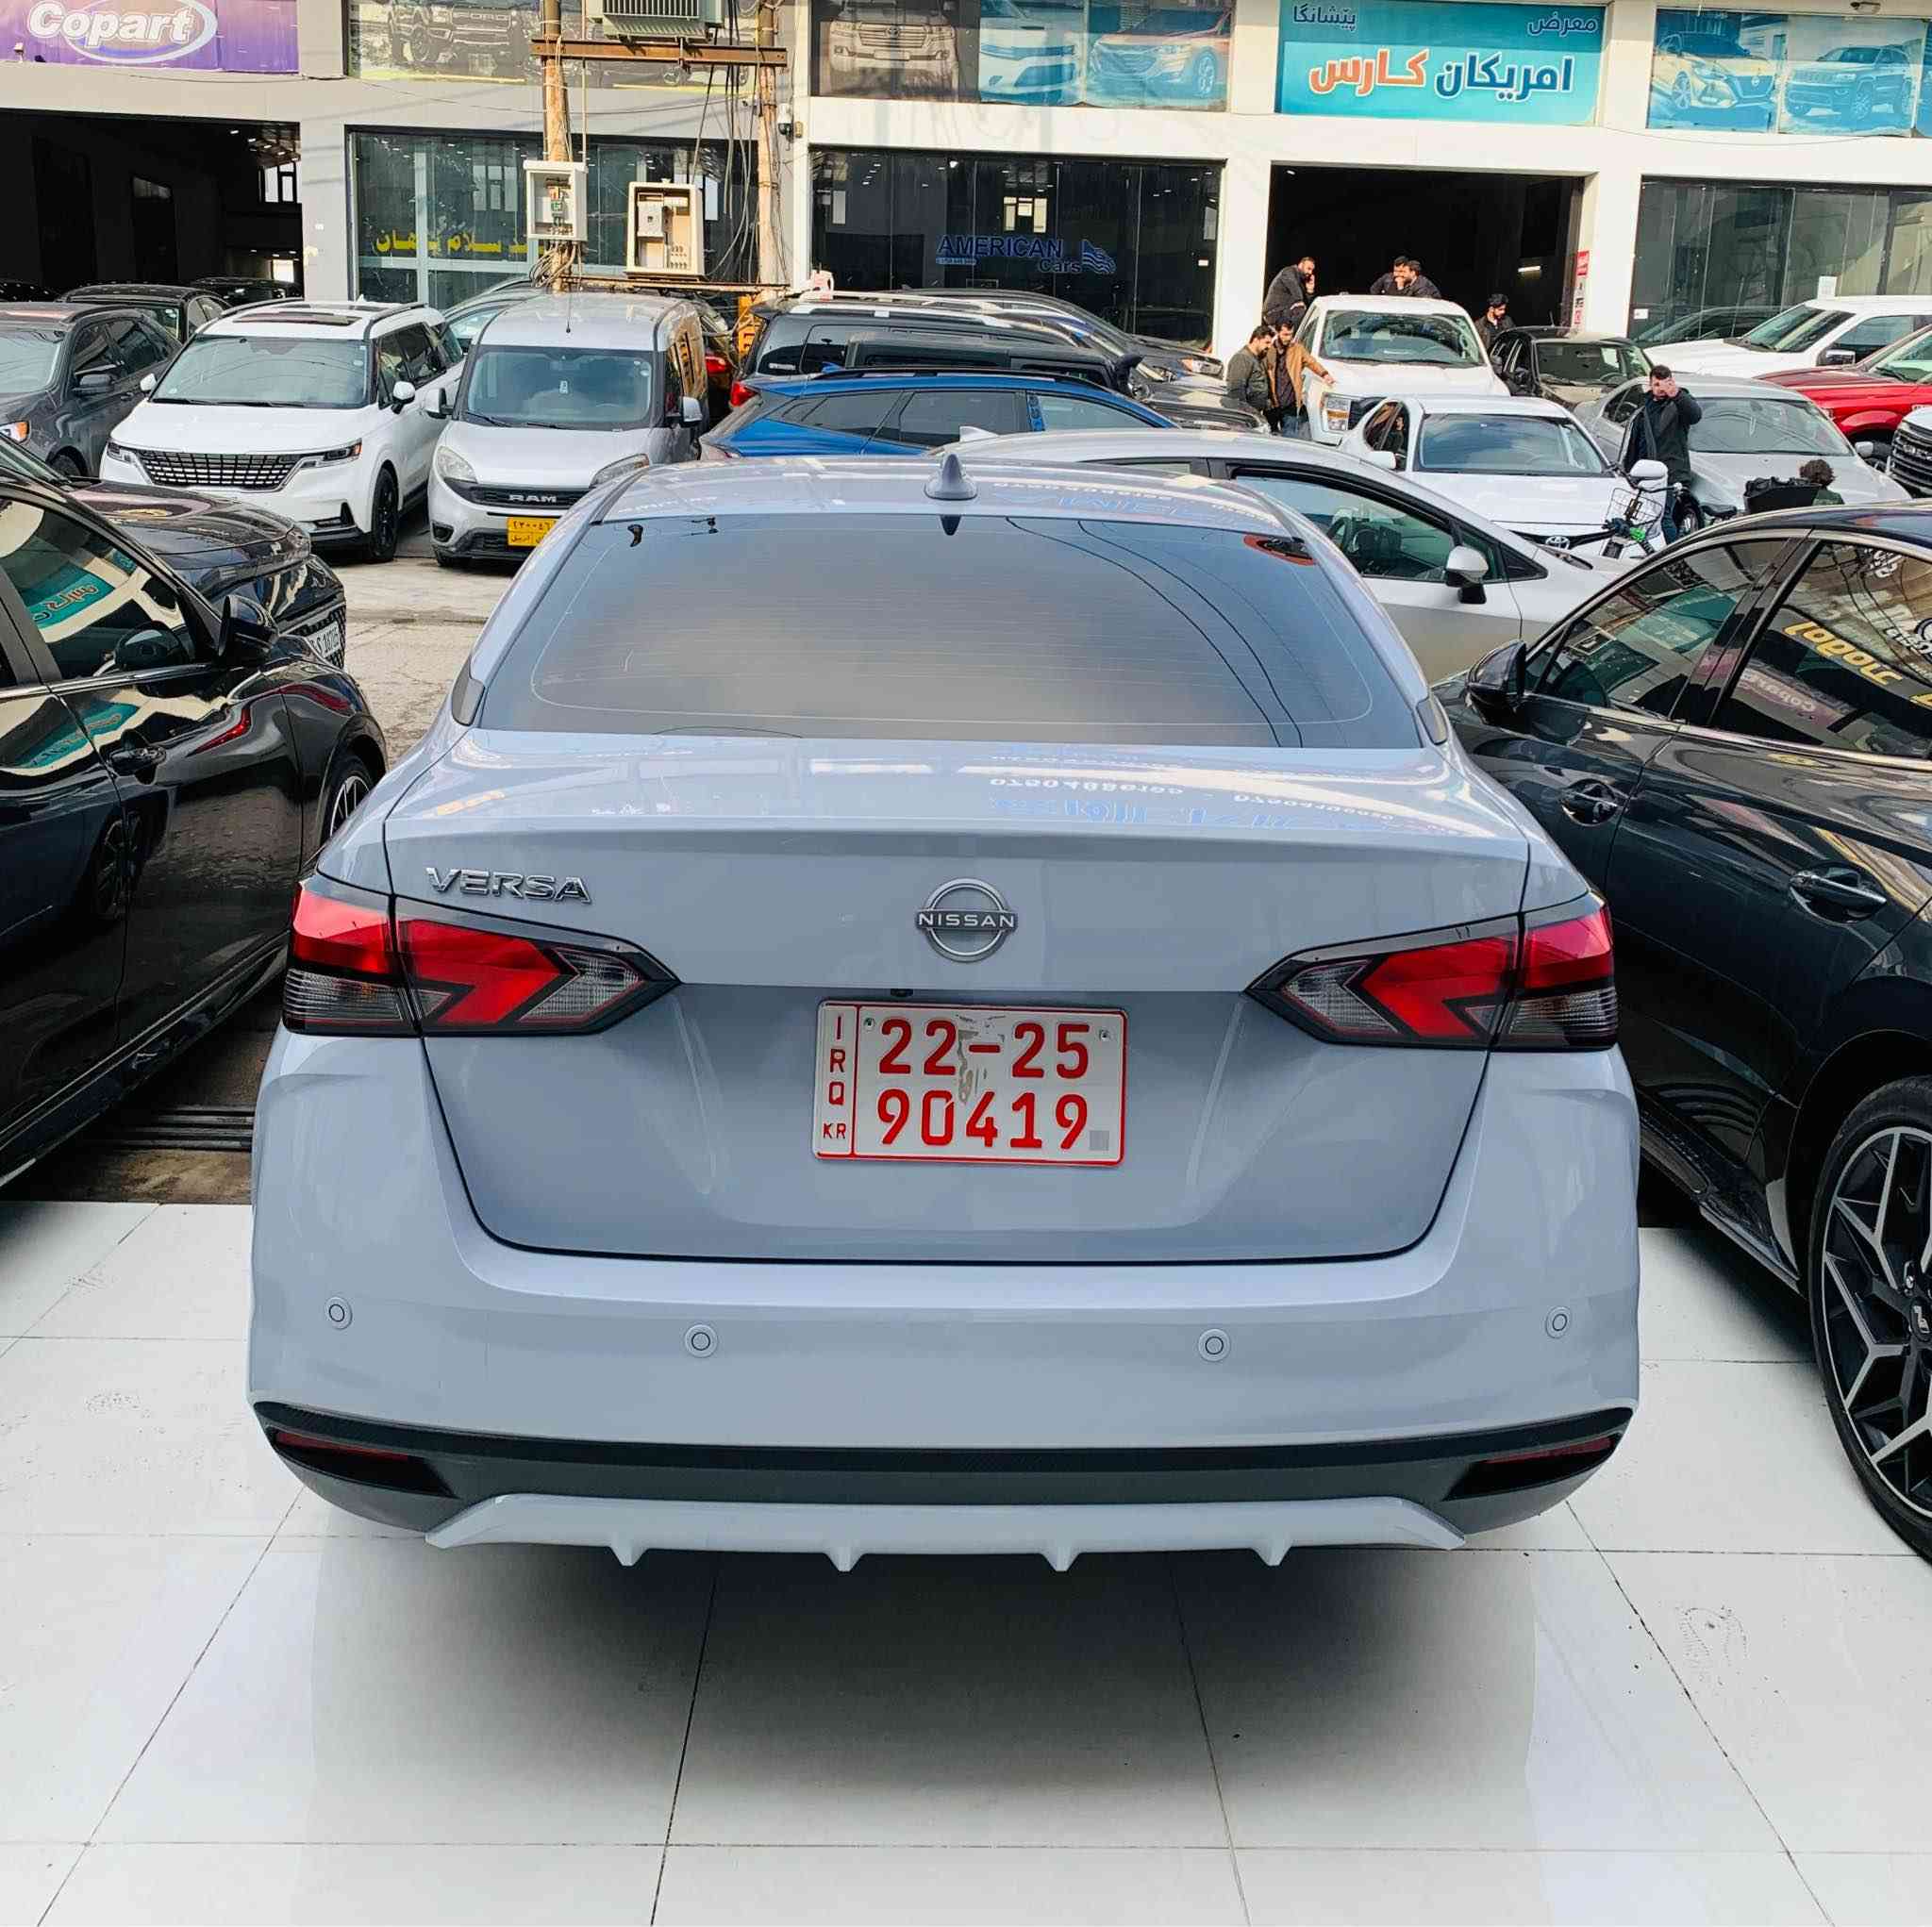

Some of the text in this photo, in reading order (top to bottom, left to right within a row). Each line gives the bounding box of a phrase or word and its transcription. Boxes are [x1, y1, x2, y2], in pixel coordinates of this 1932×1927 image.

[28, 0, 194, 47] Copart
[1528, 13, 1598, 36] معرض
[937, 236, 1064, 257] AMERICAN
[1039, 257, 1082, 274] Cars
[509, 494, 558, 503] RAM
[426, 867, 592, 905] VERSA
[918, 913, 1015, 928] NISSAN
[878, 1018, 1091, 1081] 22-25
[823, 1122, 847, 1140] KR
[876, 1088, 1089, 1152] 90419
